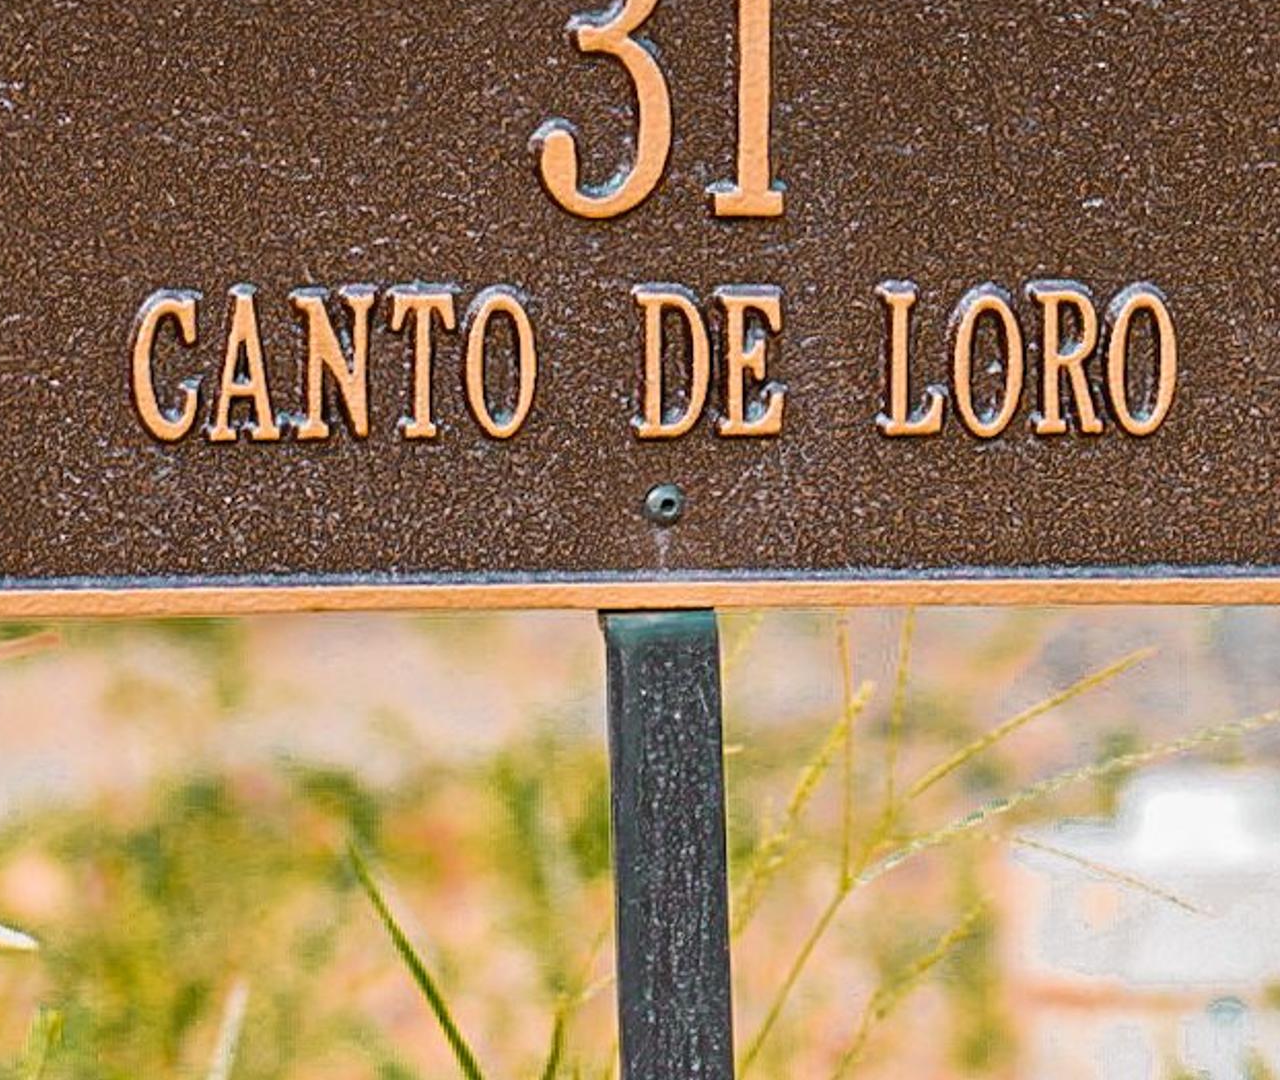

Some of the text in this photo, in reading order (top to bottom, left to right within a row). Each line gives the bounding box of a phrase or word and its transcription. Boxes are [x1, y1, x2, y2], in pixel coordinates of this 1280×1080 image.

[131, 280, 1179, 443] CANTO DE LORO
